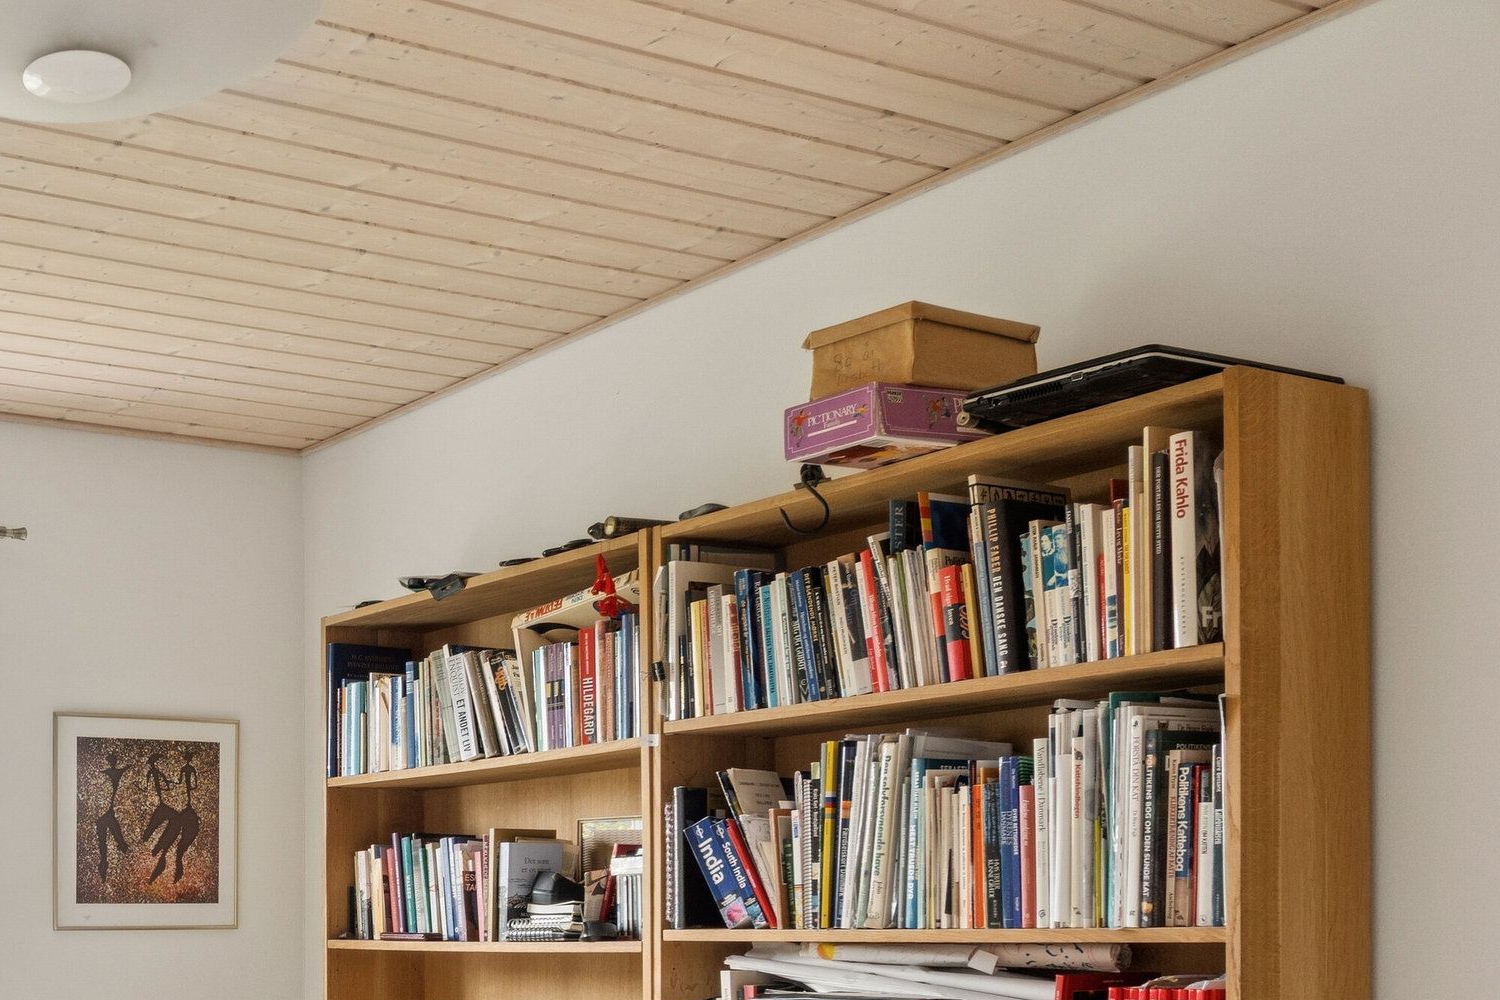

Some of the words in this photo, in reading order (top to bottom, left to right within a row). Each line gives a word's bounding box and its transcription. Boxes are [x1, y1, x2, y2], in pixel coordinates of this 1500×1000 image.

[807, 404, 857, 427] PICTIONARY
[1175, 438, 1188, 475] Frida
[1175, 477, 1190, 519] Kahlo
[987, 508, 998, 543] PHILLIP
[990, 546, 1000, 573] FABER
[993, 576, 1002, 592] DEN
[994, 596, 1005, 629] DANSKE
[998, 633, 1008, 656] SANG
[448, 658, 459, 696] ENQUIST
[457, 699, 465, 709] ET
[583, 677, 594, 735] HILDEGARD
[458, 712, 469, 737] ANDET
[462, 740, 470, 752] LIV
[1036, 746, 1048, 791] Vandløbene
[1145, 754, 1153, 800] POLITIKENS
[1074, 764, 1082, 818] Kattehåndbogen
[1177, 766, 1190, 819] Politikens
[876, 777, 890, 850] selvforsynende
[1038, 799, 1046, 832] Danmark
[1145, 821, 1151, 833] OM
[524, 857, 536, 865] Det
[698, 837, 724, 885] India
[840, 828, 849, 868] Færdselskort
[1175, 821, 1187, 871] Kattebog
[721, 841, 738, 868] South
[732, 864, 747, 889] India
[874, 853, 884, 876] have
